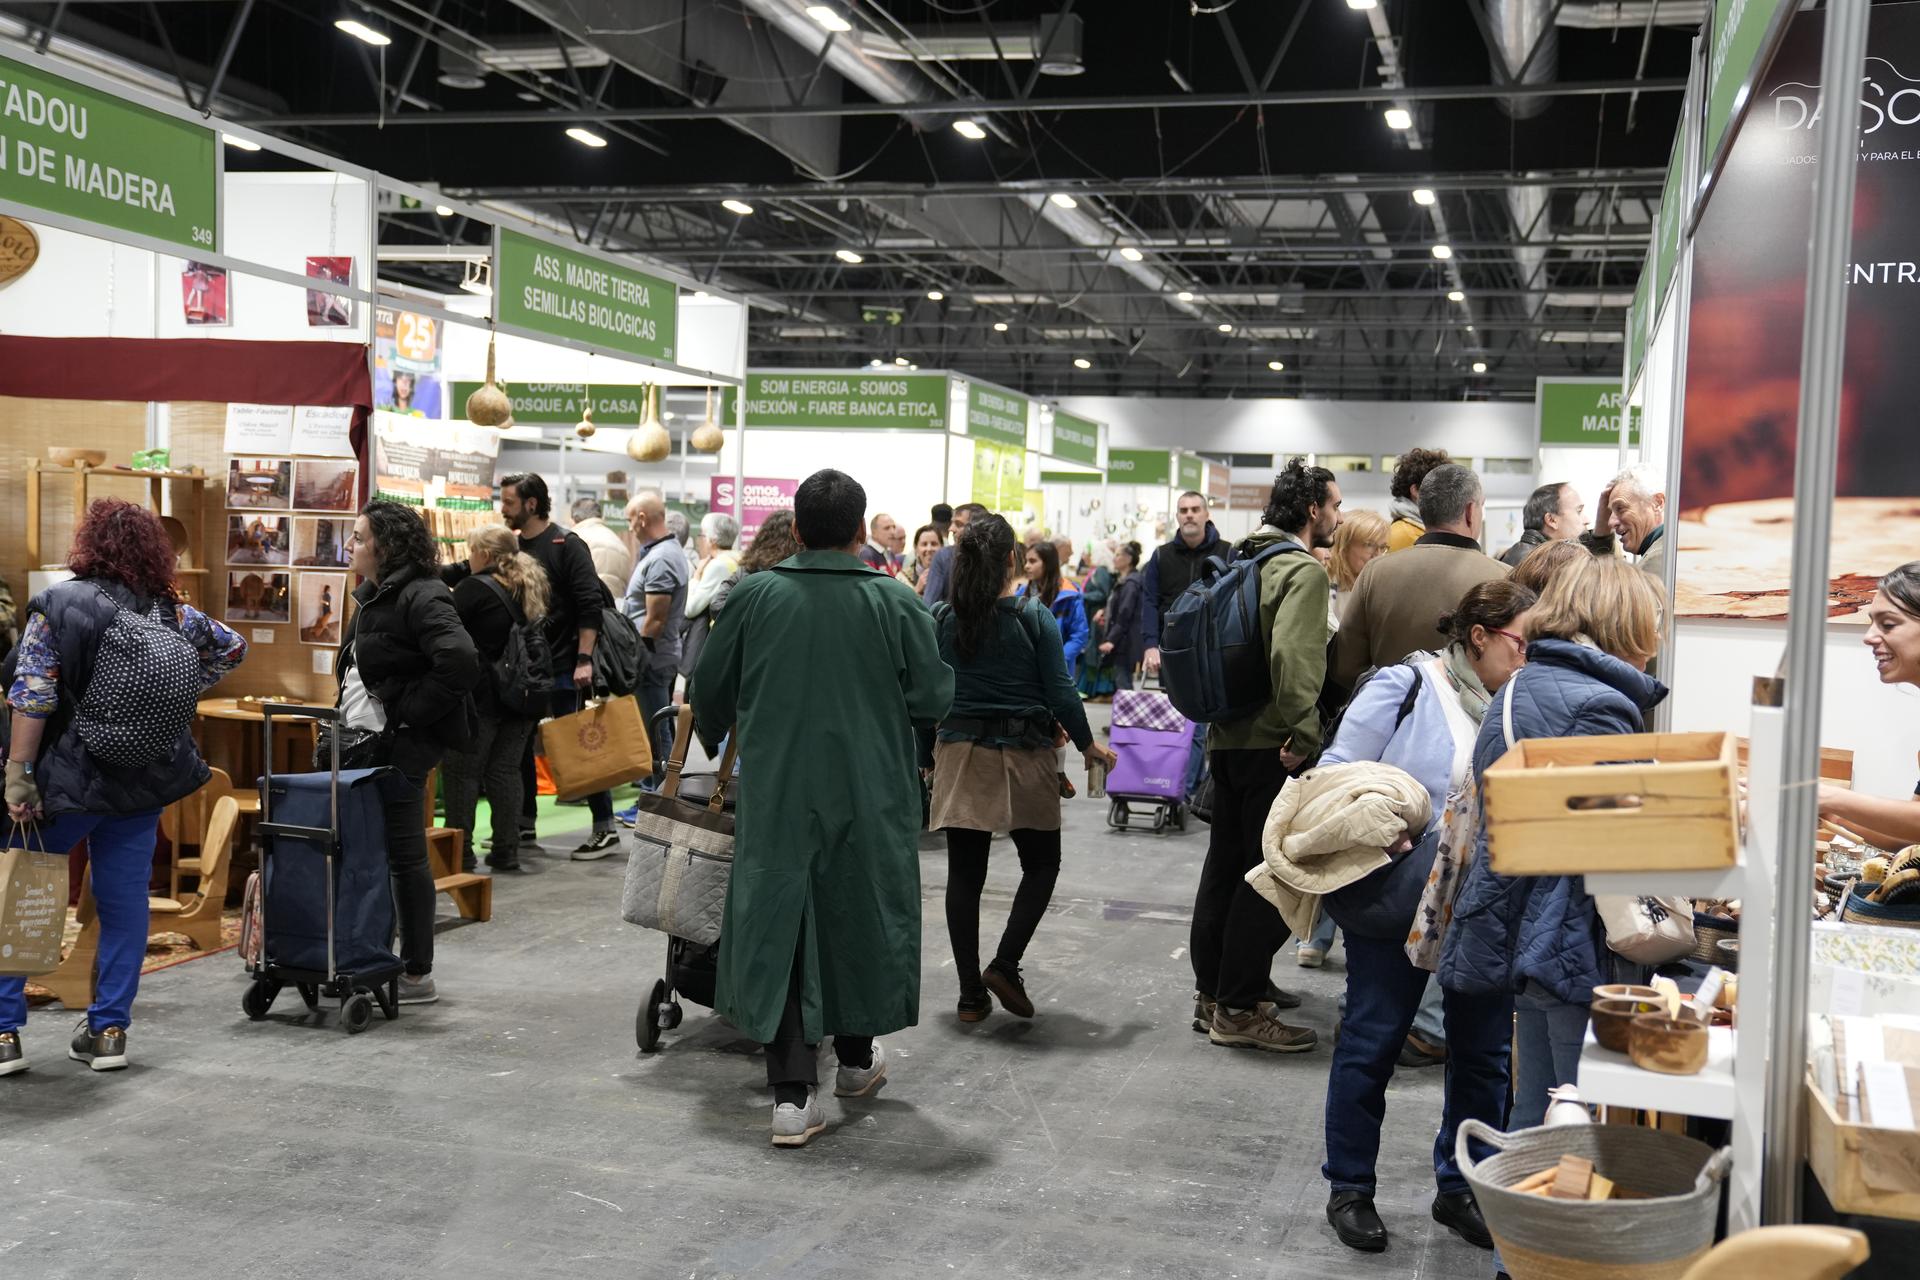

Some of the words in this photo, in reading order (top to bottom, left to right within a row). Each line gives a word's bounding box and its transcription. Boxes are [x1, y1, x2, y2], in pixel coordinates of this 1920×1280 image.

[1870, 151, 1899, 160] PARA
[1901, 150, 1914, 159] EL
[17, 140, 56, 183] DE
[65, 154, 175, 216] MADERA
[191, 226, 212, 245] 349
[534, 254, 562, 283] ASS.
[566, 262, 608, 296] MADRE
[611, 277, 650, 308] TIERRA
[1845, 262, 1920, 284] NTR
[524, 286, 585, 323] SEMILLAS
[589, 304, 656, 341] BIOLOGICAS
[403, 314, 430, 350] 25
[760, 380, 789, 395] SOM
[792, 381, 849, 395] ENERGIA
[860, 381, 907, 396] SOMOS
[565, 398, 575, 412] A
[600, 399, 638, 413] CASA
[808, 401, 846, 415] FIARE
[850, 402, 895, 416] BANCA
[899, 402, 937, 417] ETICA
